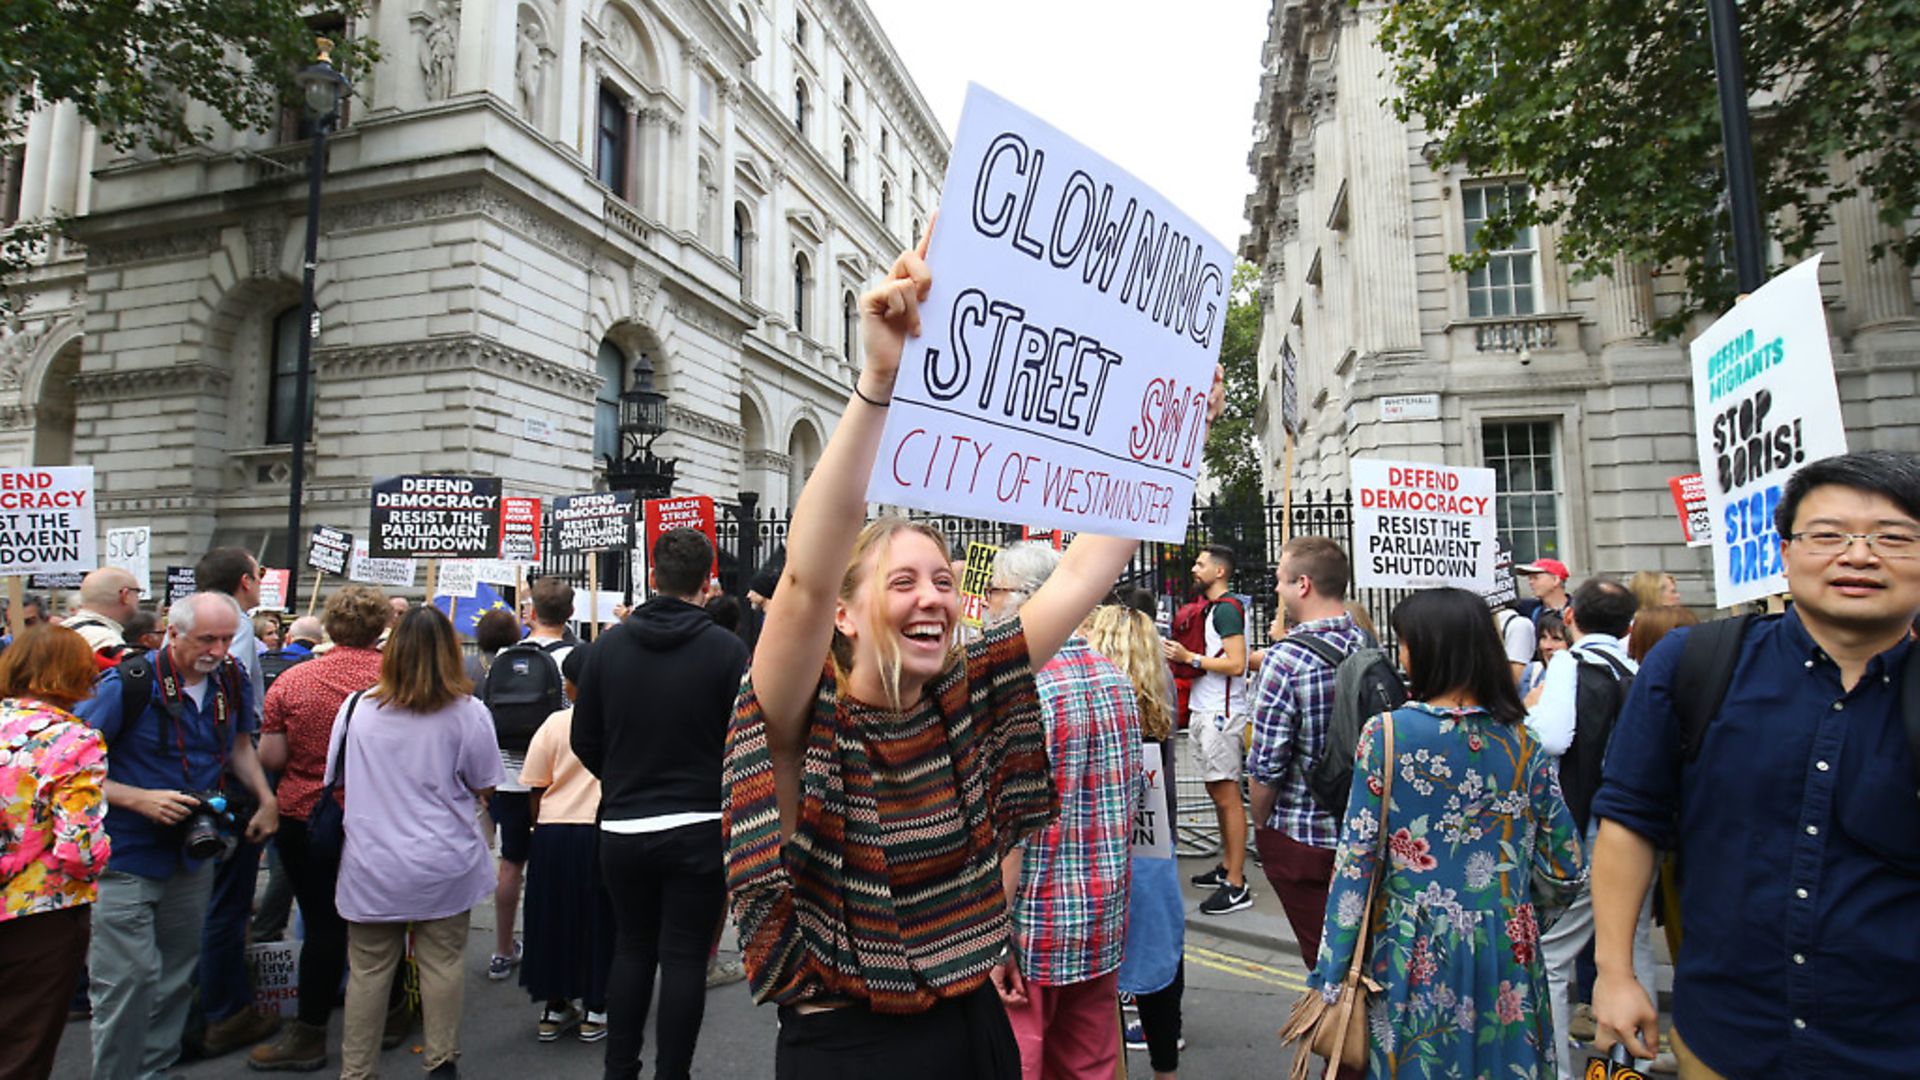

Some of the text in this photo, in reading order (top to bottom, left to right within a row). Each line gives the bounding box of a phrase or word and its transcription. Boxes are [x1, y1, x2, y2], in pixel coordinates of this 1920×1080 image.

[972, 132, 1223, 349] CLOWNING
[924, 288, 1122, 436] STREET
[1708, 328, 1755, 381] DEFEND
[1710, 336, 1784, 404] MIGRANTS
[1713, 388, 1772, 454] STOP
[1717, 417, 1805, 494] BORIS!
[1, 472, 53, 490] END
[402, 478, 474, 493] DEFEND
[892, 428, 1175, 526] CITY OF WESTMINSTER
[1389, 467, 1459, 492] DEFEND
[0, 490, 86, 509] CRACY
[376, 492, 497, 508] DEMOCRACY
[569, 494, 615, 509] DEFEND
[658, 500, 701, 512] MARCH
[1361, 488, 1489, 515] DEMOCRACY
[389, 510, 484, 524] RESIST THE
[555, 503, 632, 520] DEMOCRACY
[661, 510, 699, 521] STRIKE
[27, 513, 70, 529] THE
[381, 523, 491, 537] PARLIAMENT
[563, 516, 624, 530] RESIST THE
[659, 519, 704, 531] OCCUPY
[1378, 515, 1471, 538] RESIST THE
[0, 529, 81, 547] AMENT
[559, 525, 628, 540] PARLIAMENT
[109, 529, 147, 558] STOP
[383, 537, 487, 550] SHUTDOWN
[561, 536, 627, 550] SHUTDOWN
[1369, 535, 1481, 559] PARLIAMENT
[0, 547, 79, 564] DOWN
[967, 544, 997, 572] REM
[1729, 533, 1784, 586] BREX
[1373, 556, 1477, 578] SHUTDOWN
